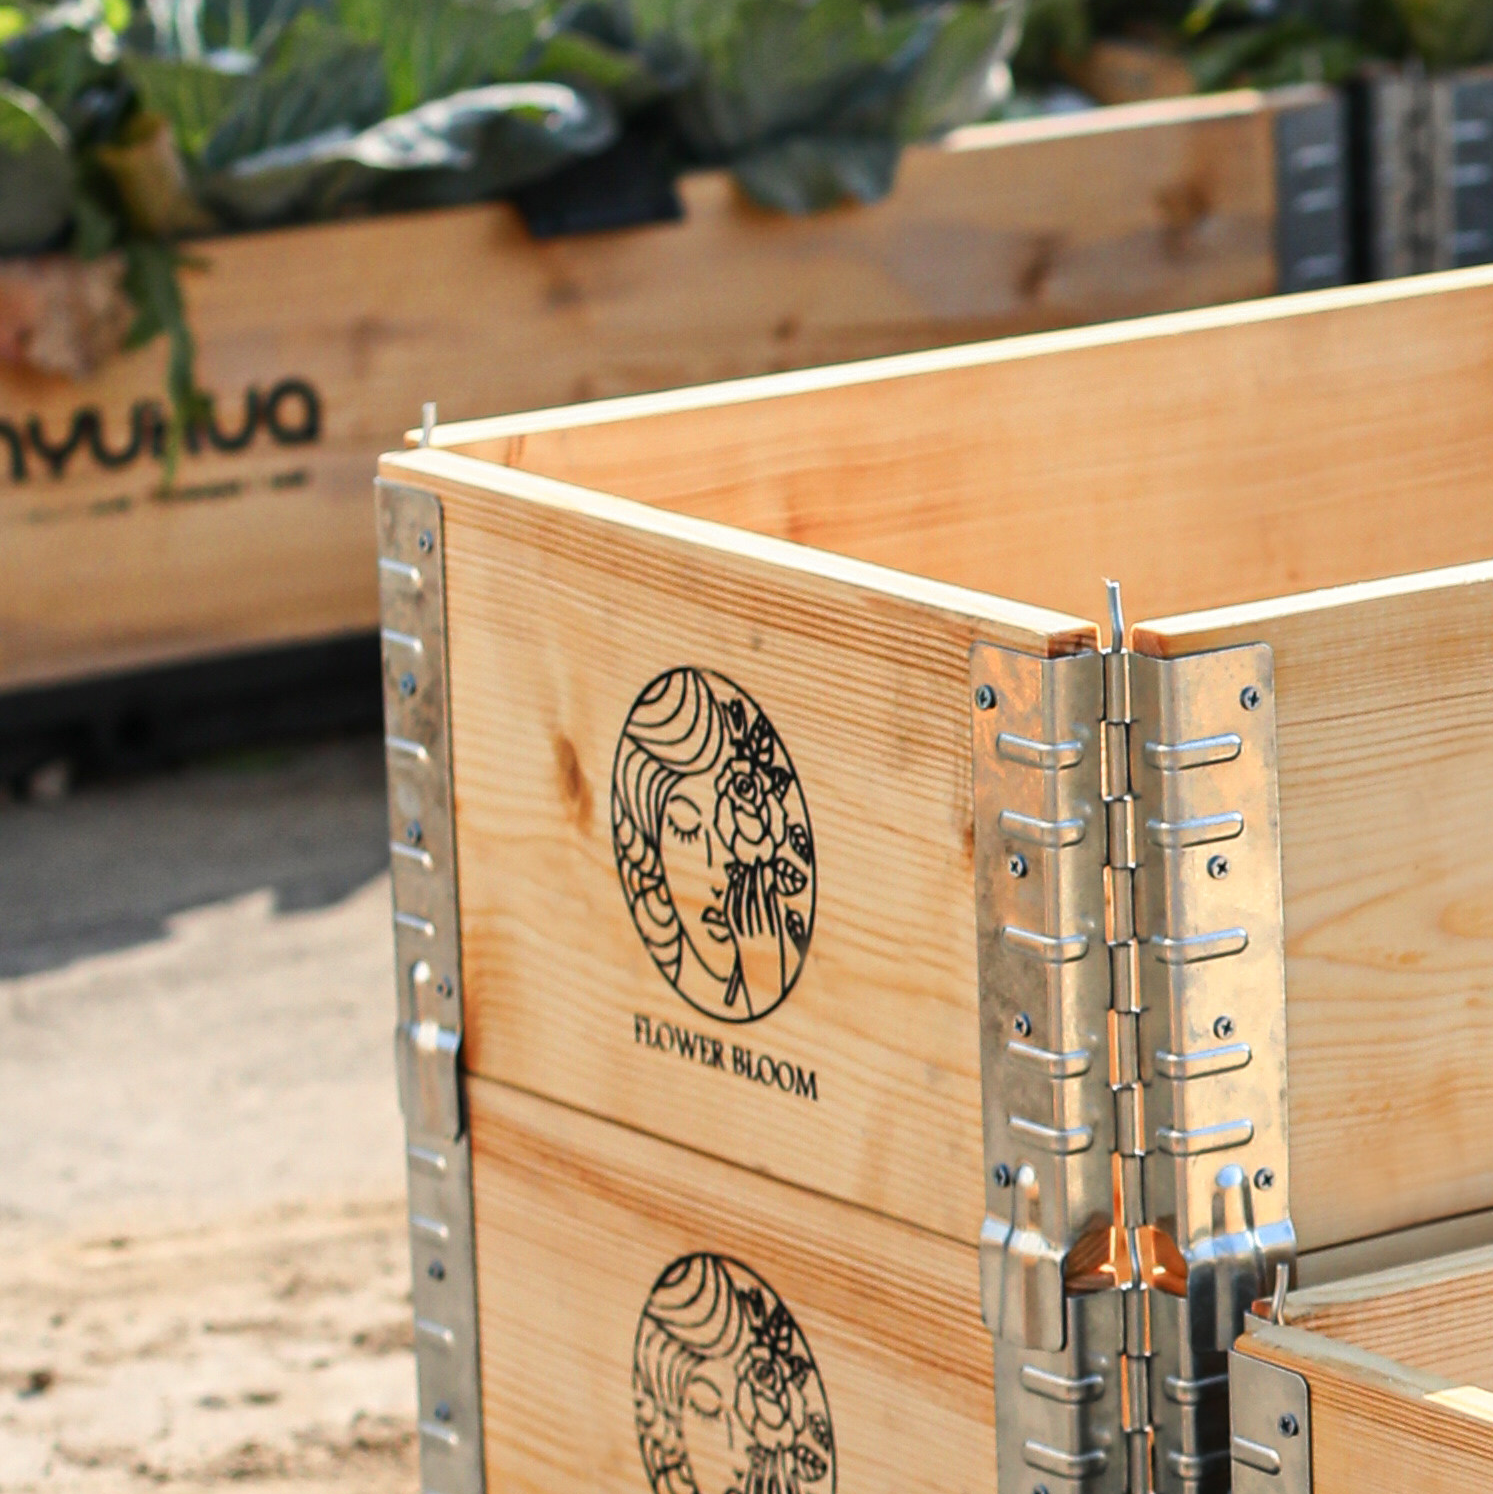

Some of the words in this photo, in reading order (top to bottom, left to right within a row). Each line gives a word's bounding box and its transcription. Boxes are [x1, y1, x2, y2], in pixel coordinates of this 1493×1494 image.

[0, 377, 321, 484] YUUA
[634, 1013, 725, 1071] FLOWER
[732, 1045, 818, 1101] BLOOM
